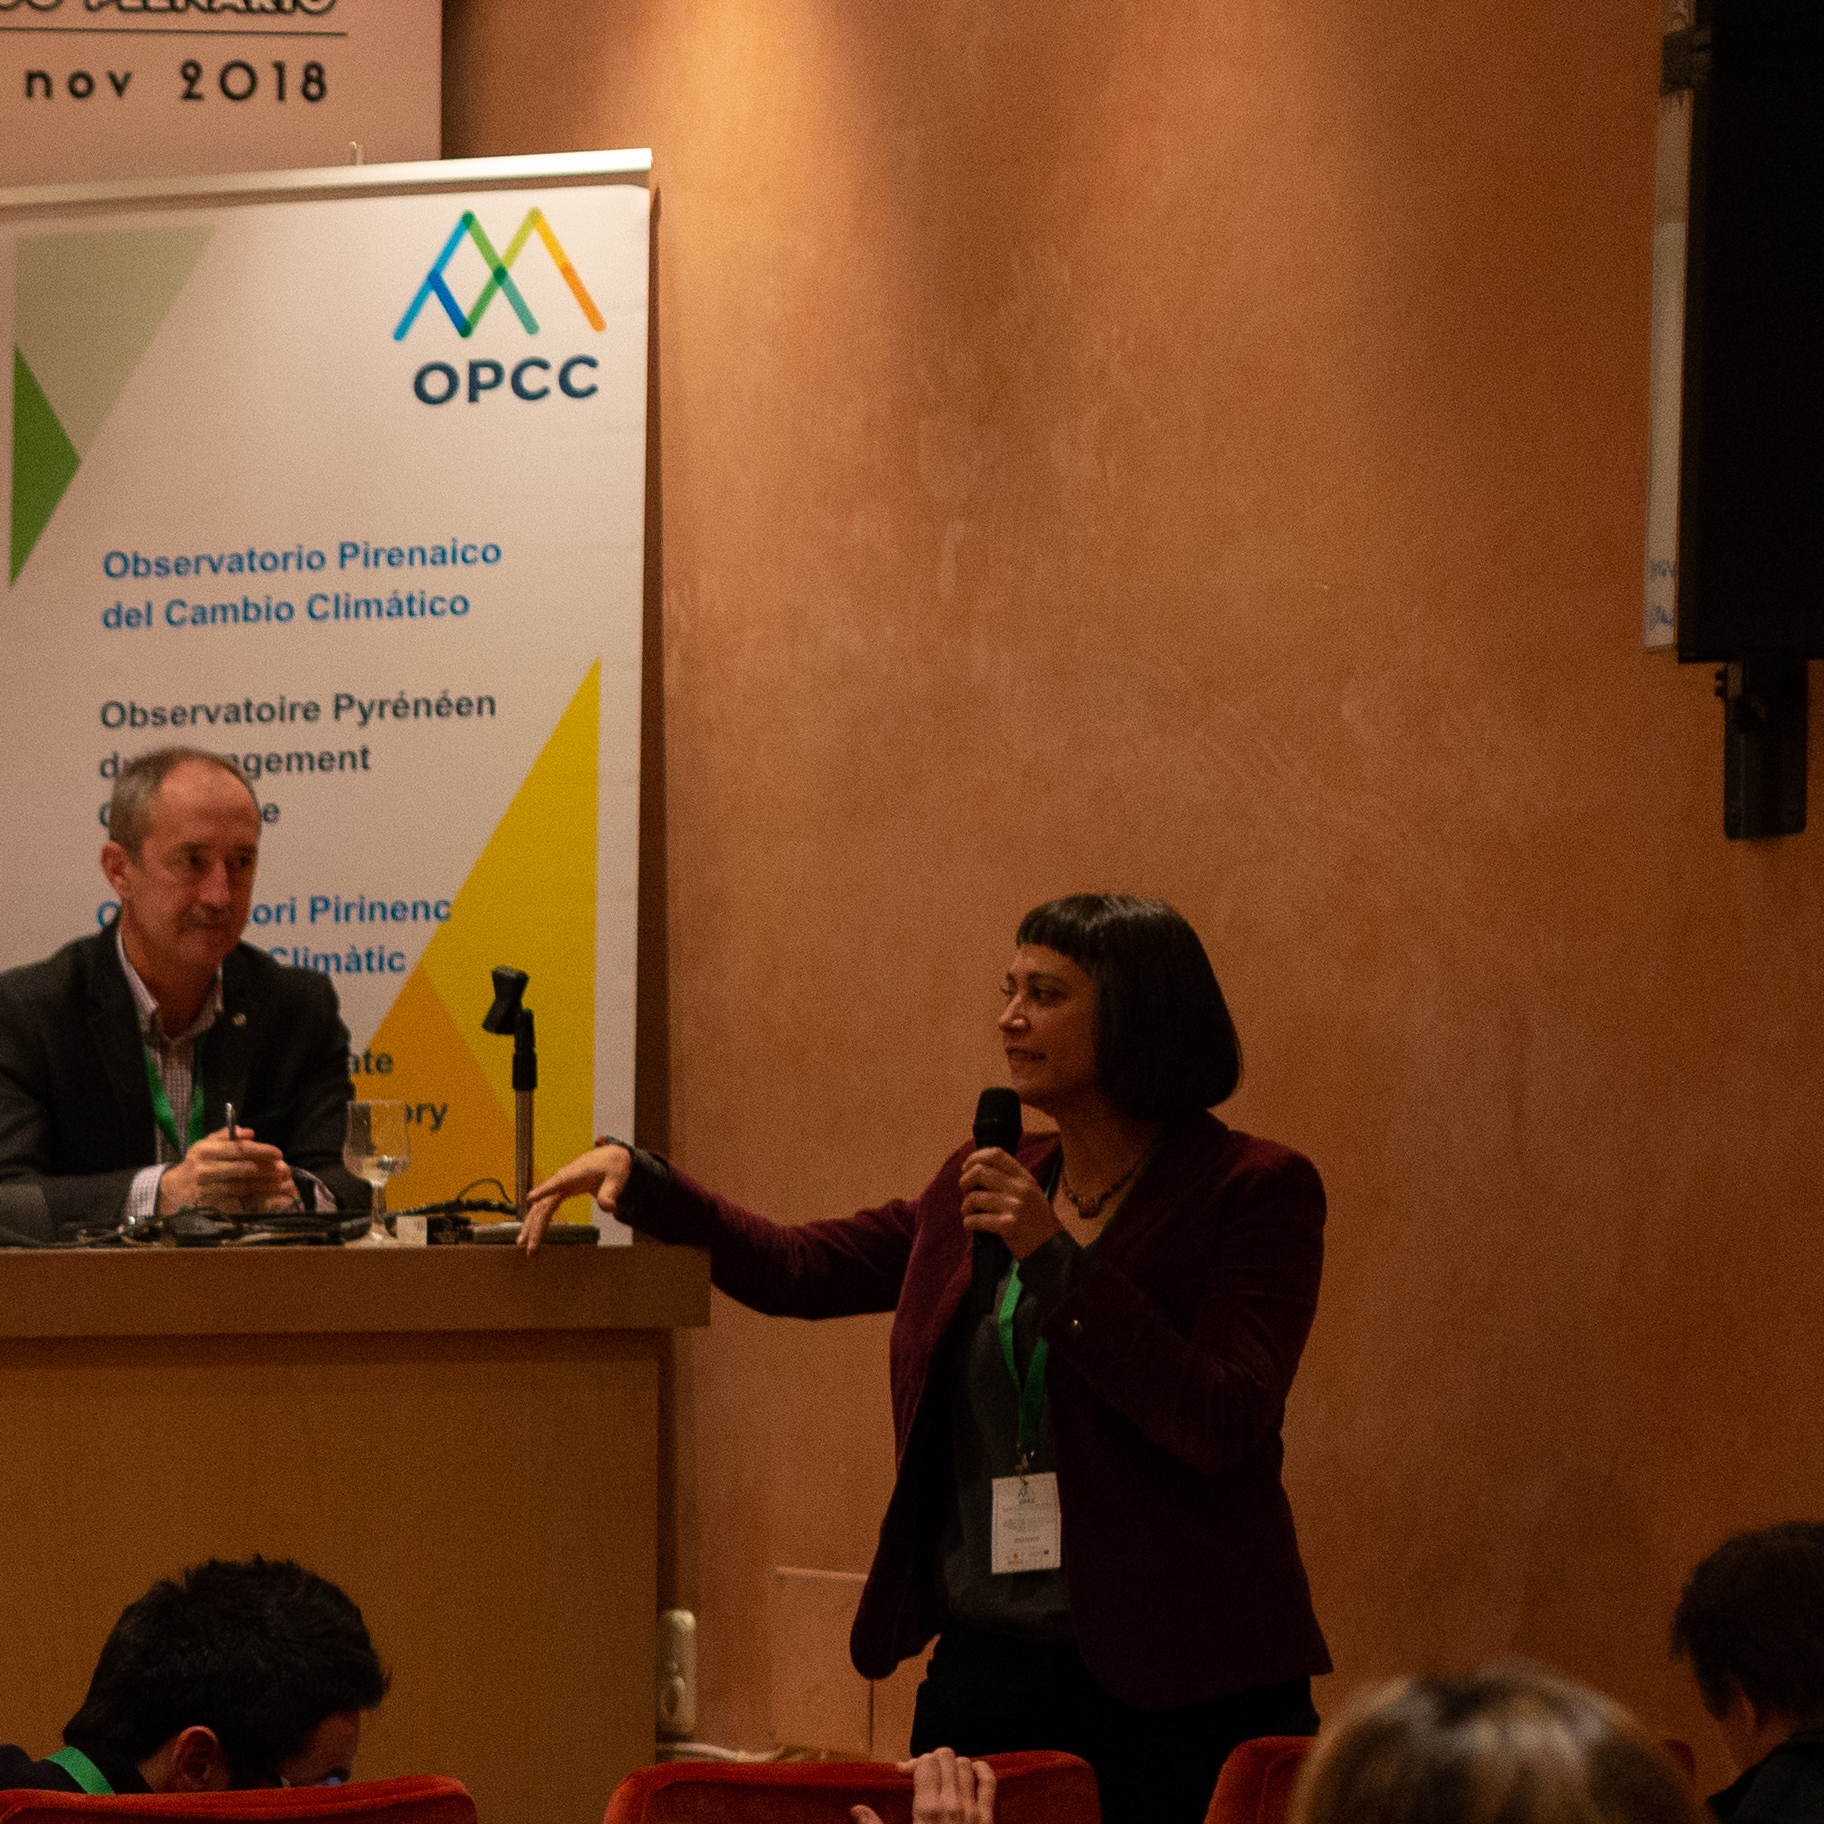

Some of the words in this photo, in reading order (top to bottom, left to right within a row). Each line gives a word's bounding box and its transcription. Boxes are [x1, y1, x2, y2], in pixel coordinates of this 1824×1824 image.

[24, 69, 132, 100] nov
[179, 58, 328, 103] 2018
[412, 353, 600, 406] OPCC
[102, 545, 327, 578] Observatorio
[338, 537, 503, 570] Pirenaico
[102, 601, 154, 629] del
[164, 595, 297, 627] Cambio
[307, 589, 471, 621] Climático
[101, 695, 322, 728] Observatoire
[334, 689, 498, 727] Pyrénéen
[100, 752, 128, 780] d
[231, 745, 371, 781] gement
[309, 895, 452, 925] Pirinenc
